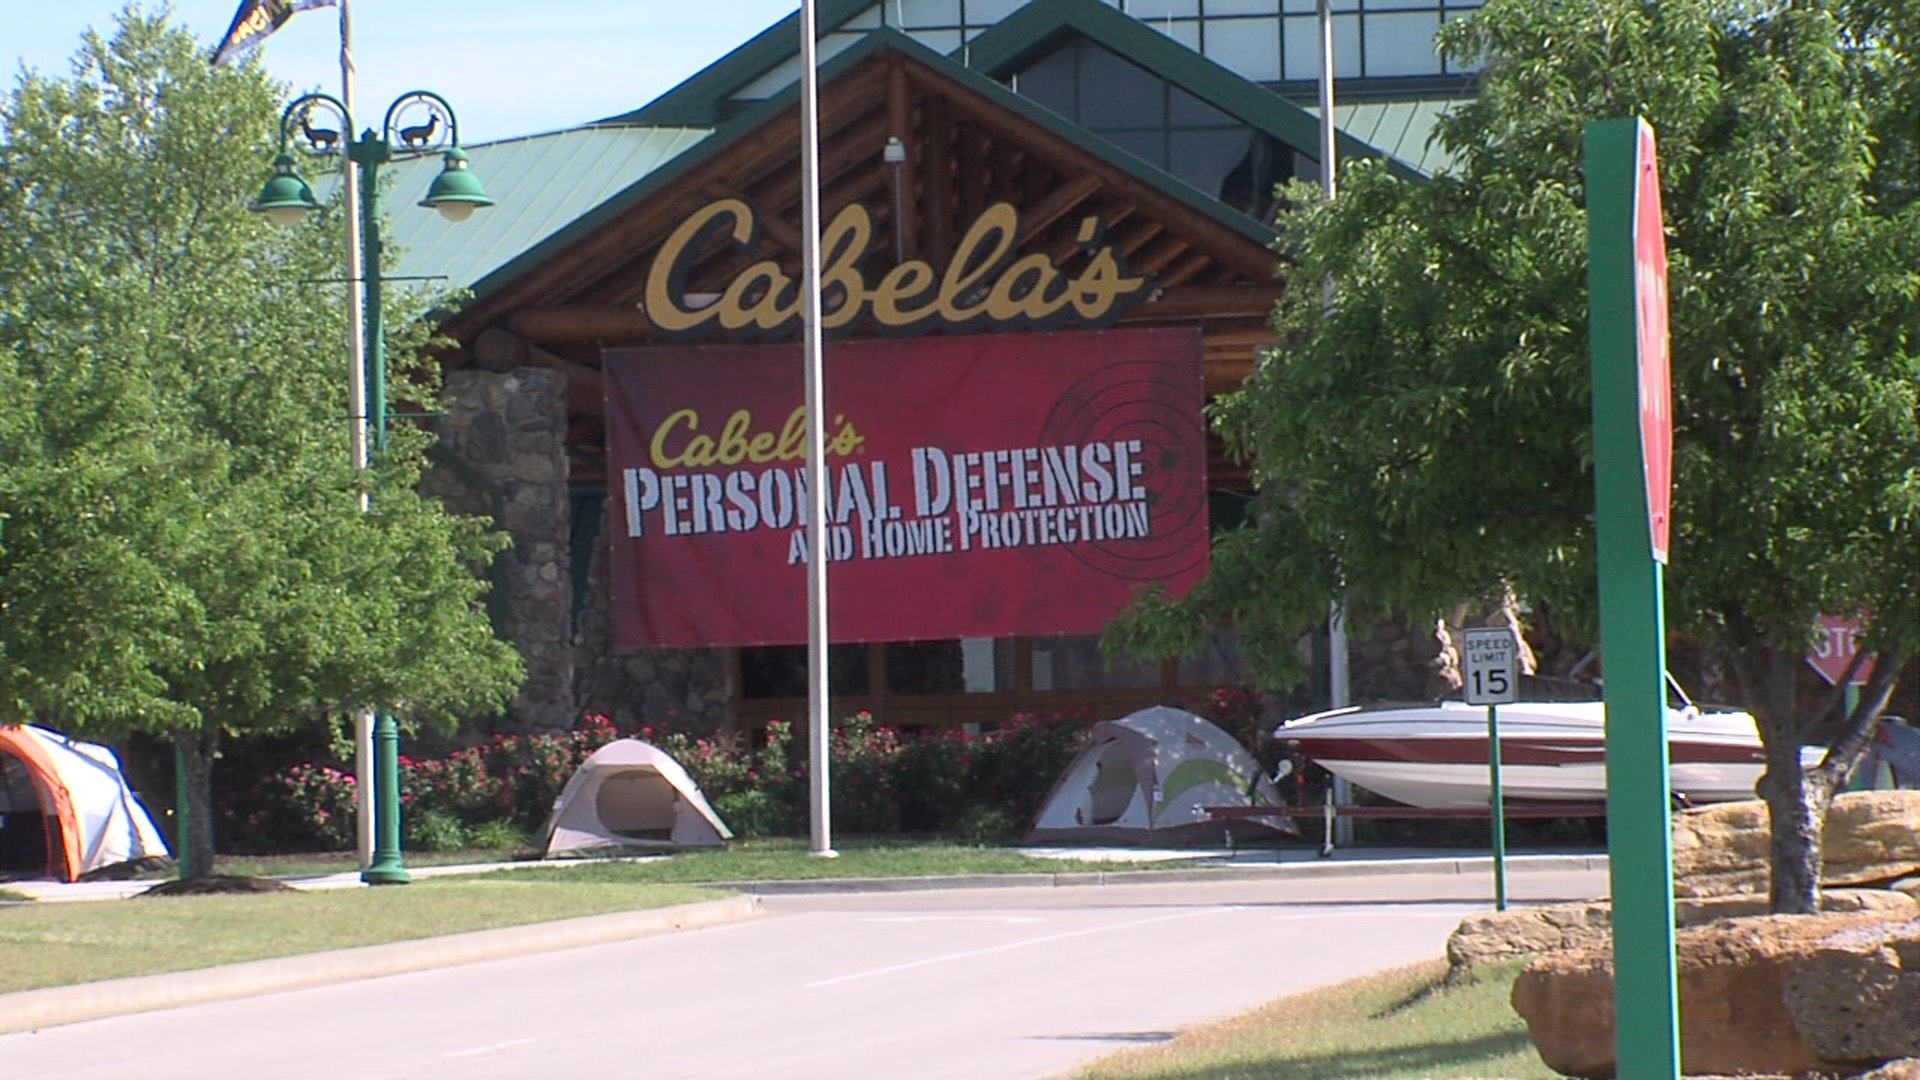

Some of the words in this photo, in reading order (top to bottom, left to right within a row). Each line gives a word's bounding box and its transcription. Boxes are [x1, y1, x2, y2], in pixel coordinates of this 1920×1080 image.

[645, 199, 1144, 331] Cabela's
[651, 406, 864, 468] Cabel's
[623, 460, 902, 538] PERSONAL
[912, 439, 1147, 517] DEFENSE
[862, 517, 953, 559] HOME
[959, 501, 1149, 550] PROTECTION
[1467, 638, 1511, 650] SPEED
[1472, 651, 1506, 663] LIMIT
[1472, 668, 1508, 696] 15
